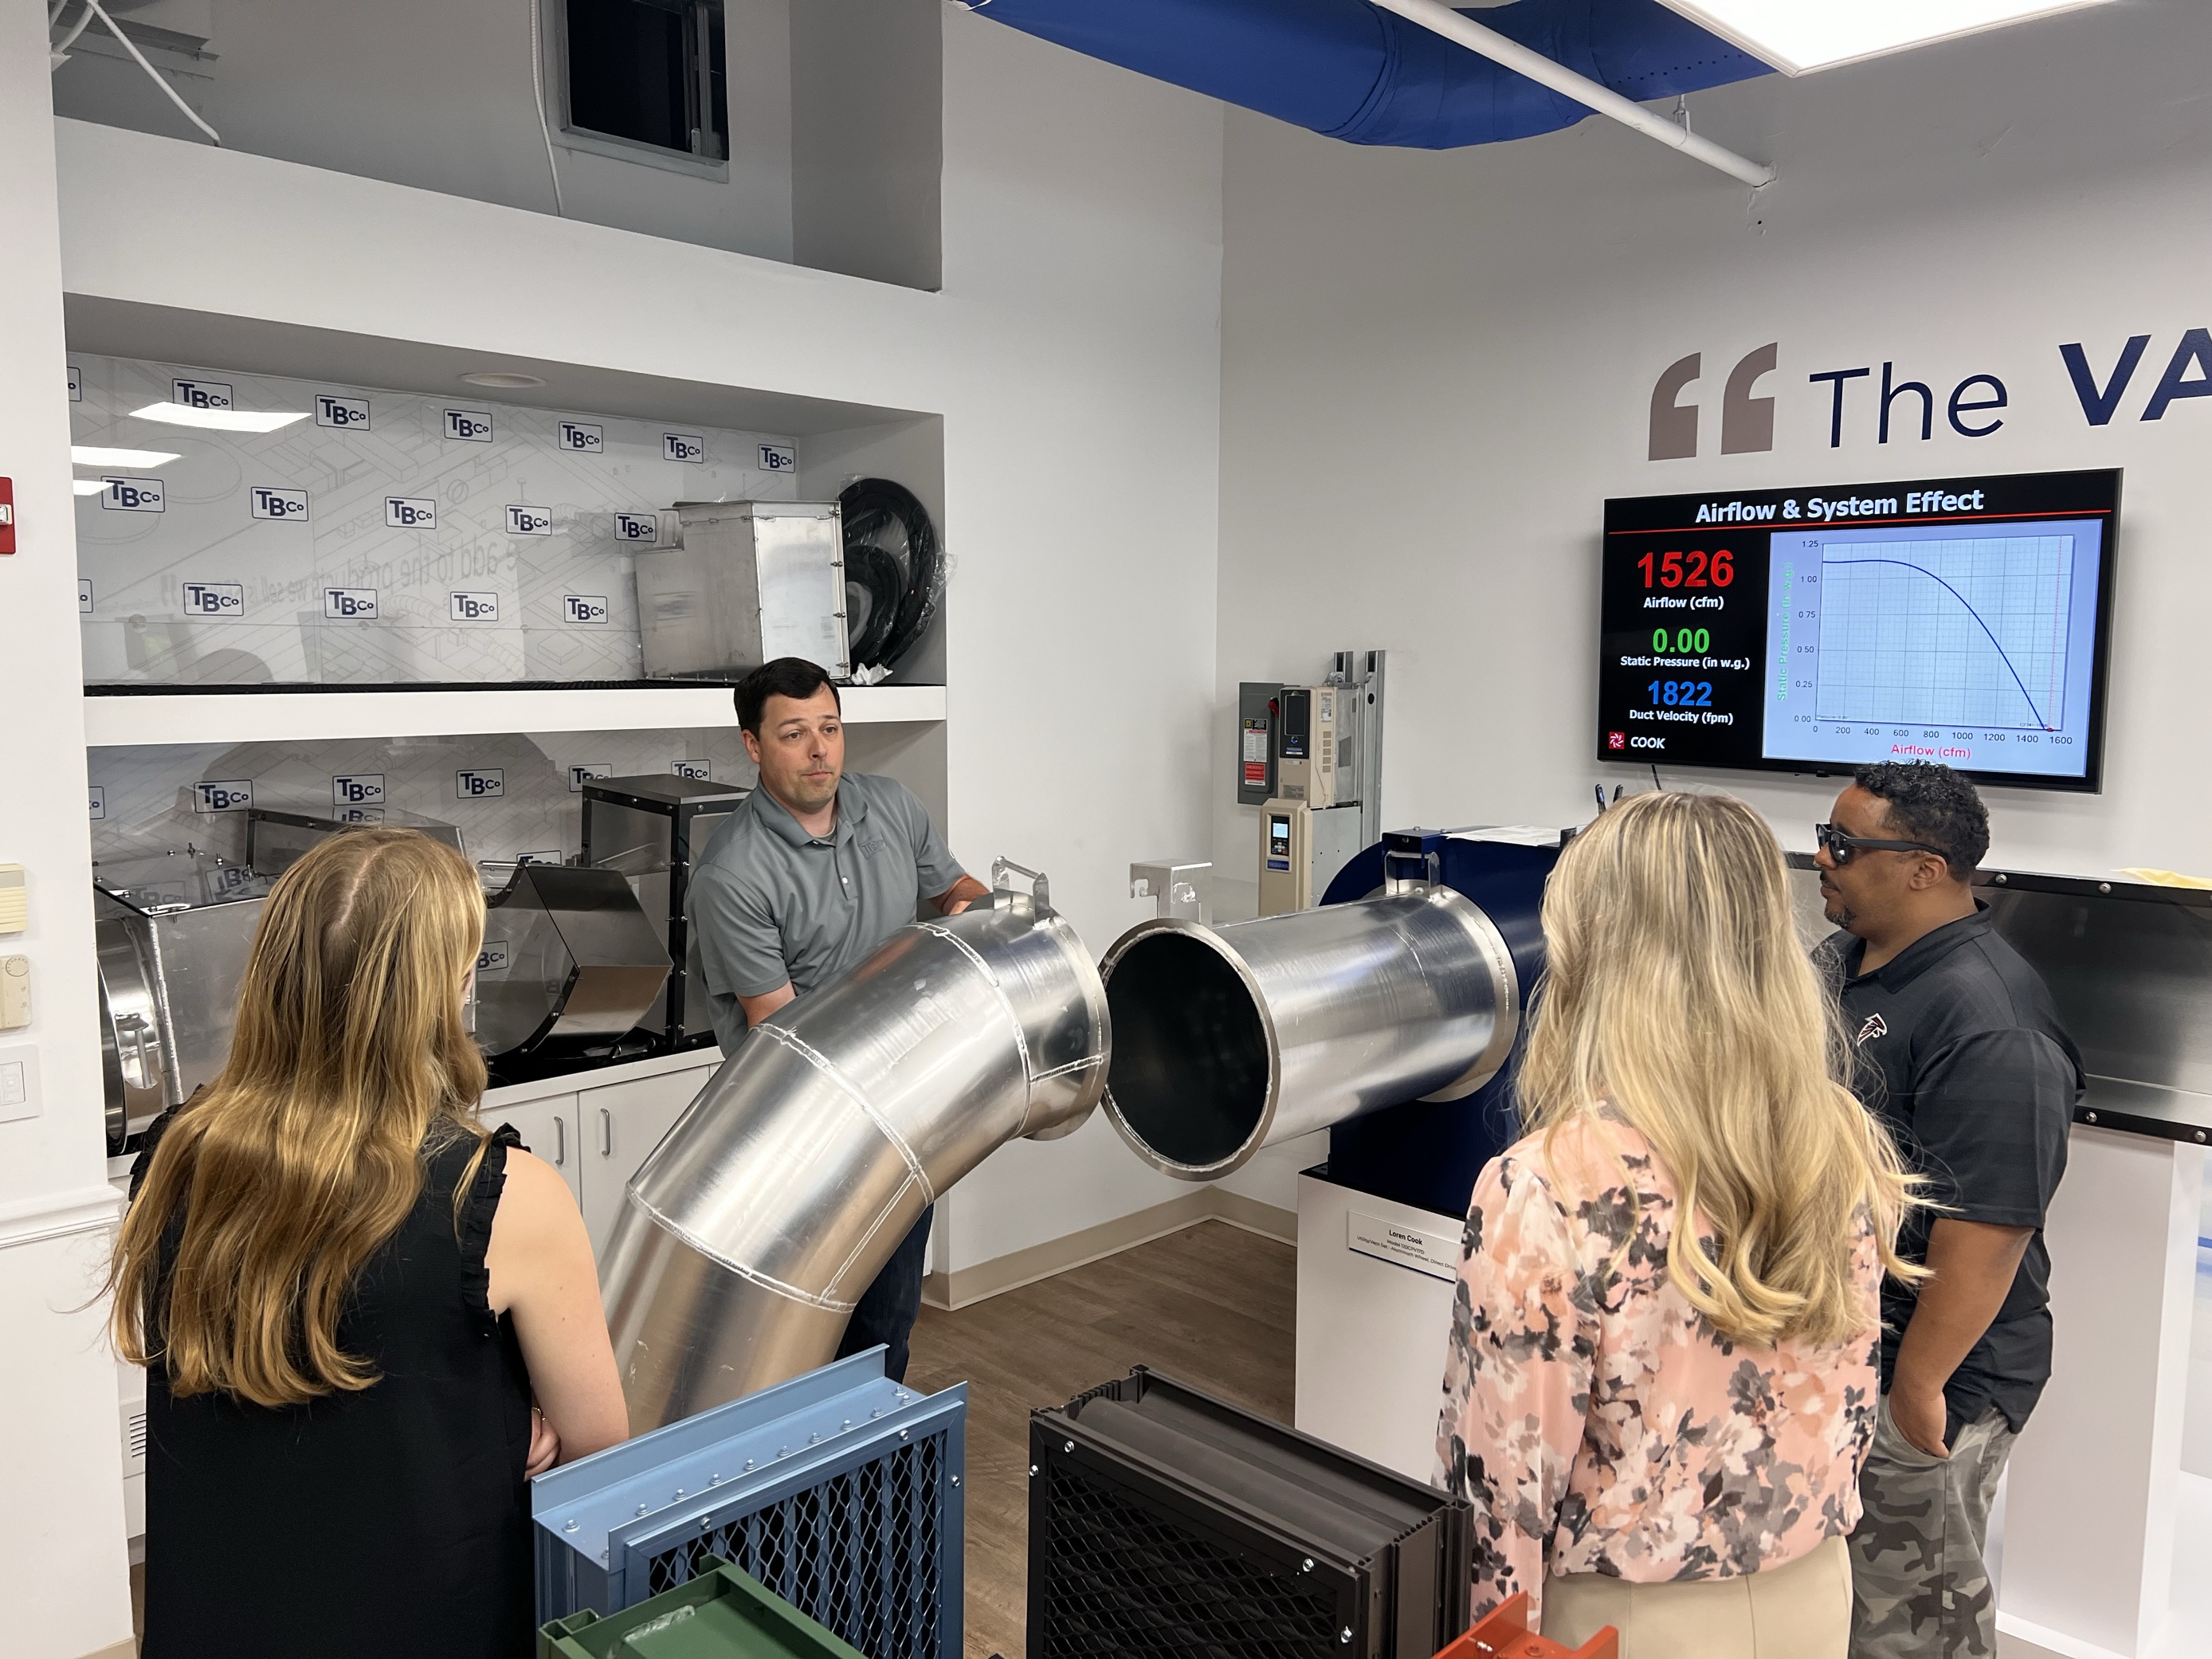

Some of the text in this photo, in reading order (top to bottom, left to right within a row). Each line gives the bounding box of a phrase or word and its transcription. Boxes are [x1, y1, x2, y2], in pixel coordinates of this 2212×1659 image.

[320, 399, 366, 425] TBCo
[448, 413, 488, 437] TBCo
[563, 426, 600, 448] TBCo
[667, 437, 700, 458] TBCo
[761, 448, 793, 469] TBCo
[107, 481, 159, 508] TBCo
[256, 491, 304, 516] TBCo
[390, 500, 433, 525] TBCo
[1696, 490, 1984, 523] Airflow & System Effect
[509, 508, 548, 531] TBCo
[618, 517, 653, 539] TBCo
[1637, 549, 1735, 588] 1526
[188, 586, 239, 611] TBCo
[328, 592, 374, 616] TBCo
[454, 595, 495, 618] TBCo
[567, 599, 605, 620] TBCo
[1643, 596, 1724, 610] Airflow (cfm)
[1653, 628, 1710, 653] 0.00
[1779, 612, 1790, 665] Pressure
[1620, 656, 1751, 670] Static Pressure (in w.g.)
[1648, 680, 1712, 707] 1822
[1777, 668, 1787, 701] Static
[1630, 710, 1734, 725] Duct Velocity (fpm)
[1630, 736, 1666, 749] COOK
[1891, 744, 1971, 760] Airflow (cfm)
[336, 779, 382, 802] TBCo
[460, 773, 500, 794] TBCo
[198, 785, 249, 809] TBCo
[1389, 1230, 1423, 1245] Loren Cook
